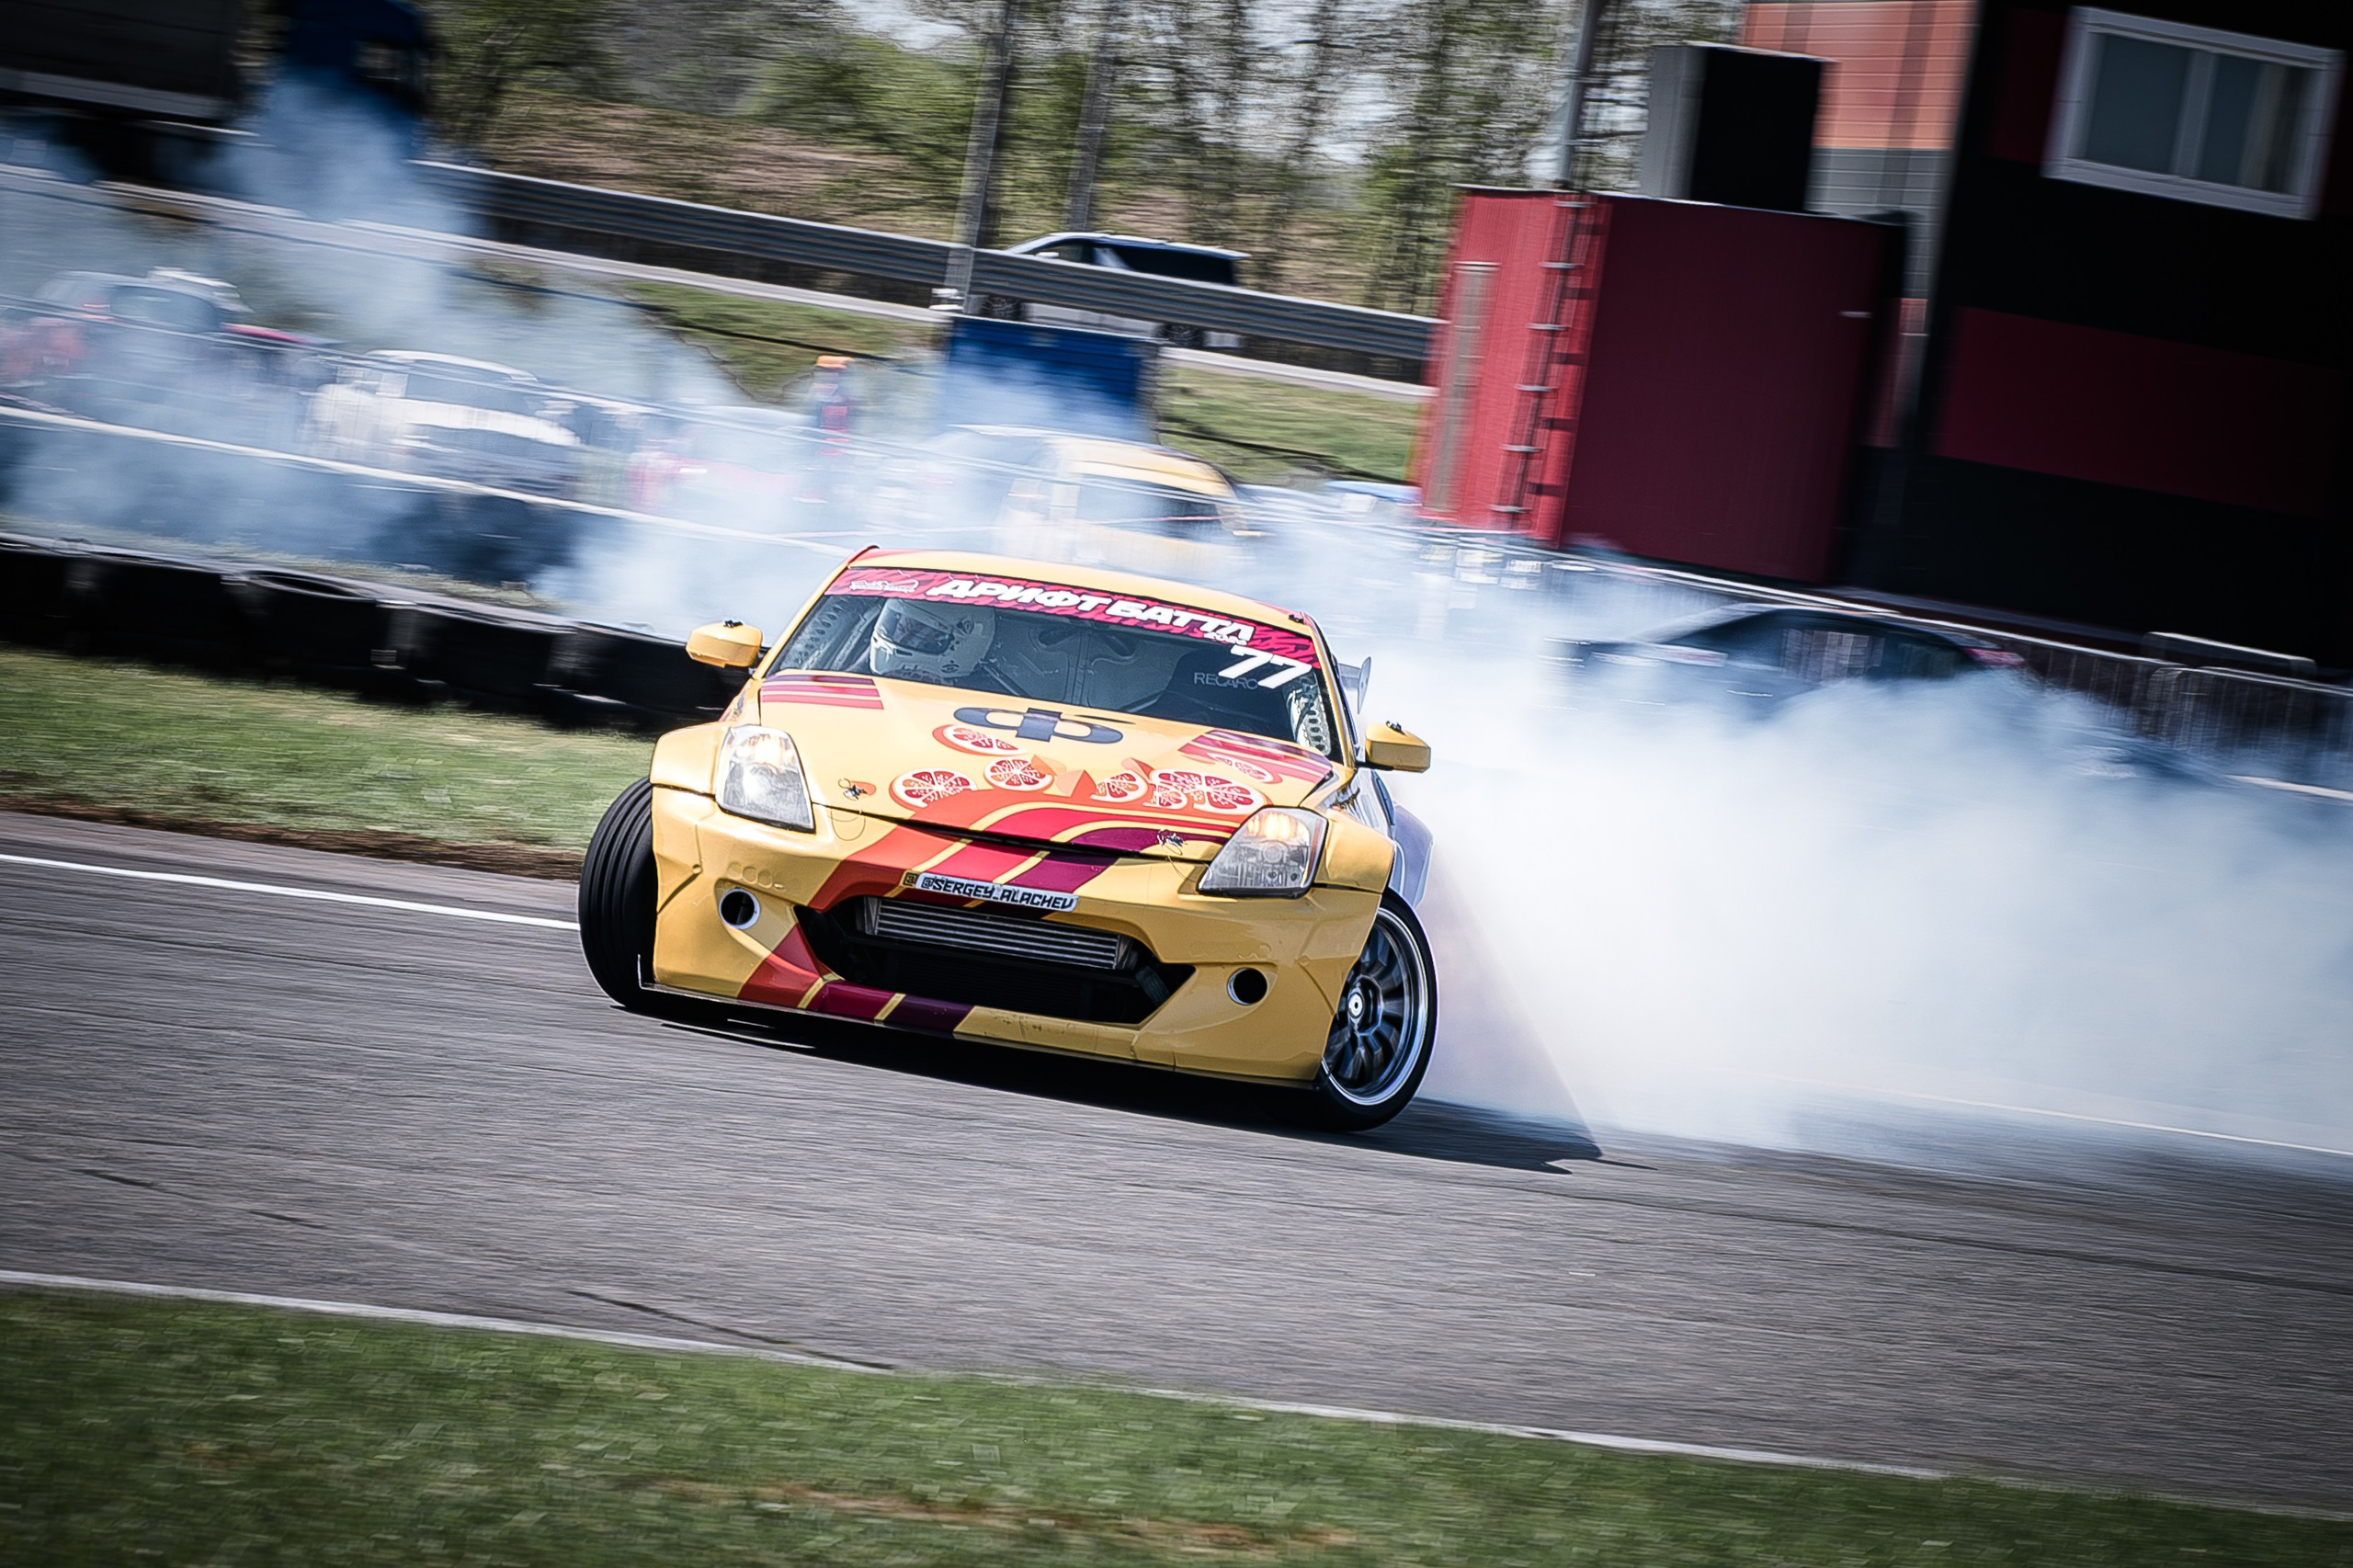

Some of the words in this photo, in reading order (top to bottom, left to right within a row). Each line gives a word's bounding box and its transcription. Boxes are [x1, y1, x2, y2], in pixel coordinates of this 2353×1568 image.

[926, 579, 1112, 612] ДРИФТ
[1105, 599, 1256, 642] БАТТЛ
[1218, 644, 1313, 689] 77
